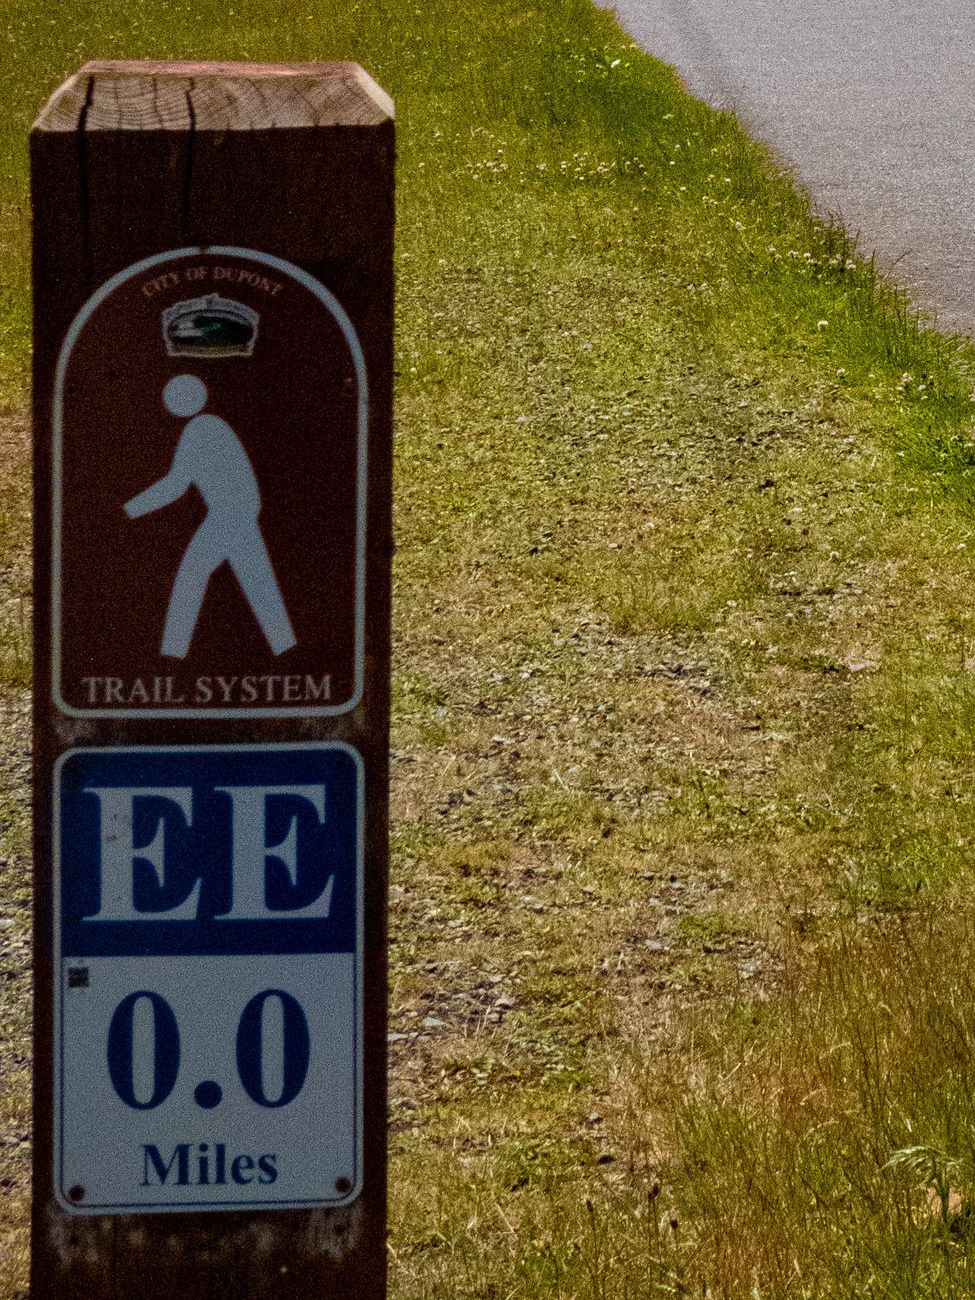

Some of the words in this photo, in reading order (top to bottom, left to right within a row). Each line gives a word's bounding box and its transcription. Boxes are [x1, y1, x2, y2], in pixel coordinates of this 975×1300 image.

[142, 271, 180, 296] CITY
[186, 267, 208, 280] OF
[82, 676, 184, 703] TRAIL
[195, 674, 334, 702] SYSTEM
[82, 785, 335, 921] EE
[107, 988, 311, 1111] 0.0
[140, 1142, 279, 1187] Miles
